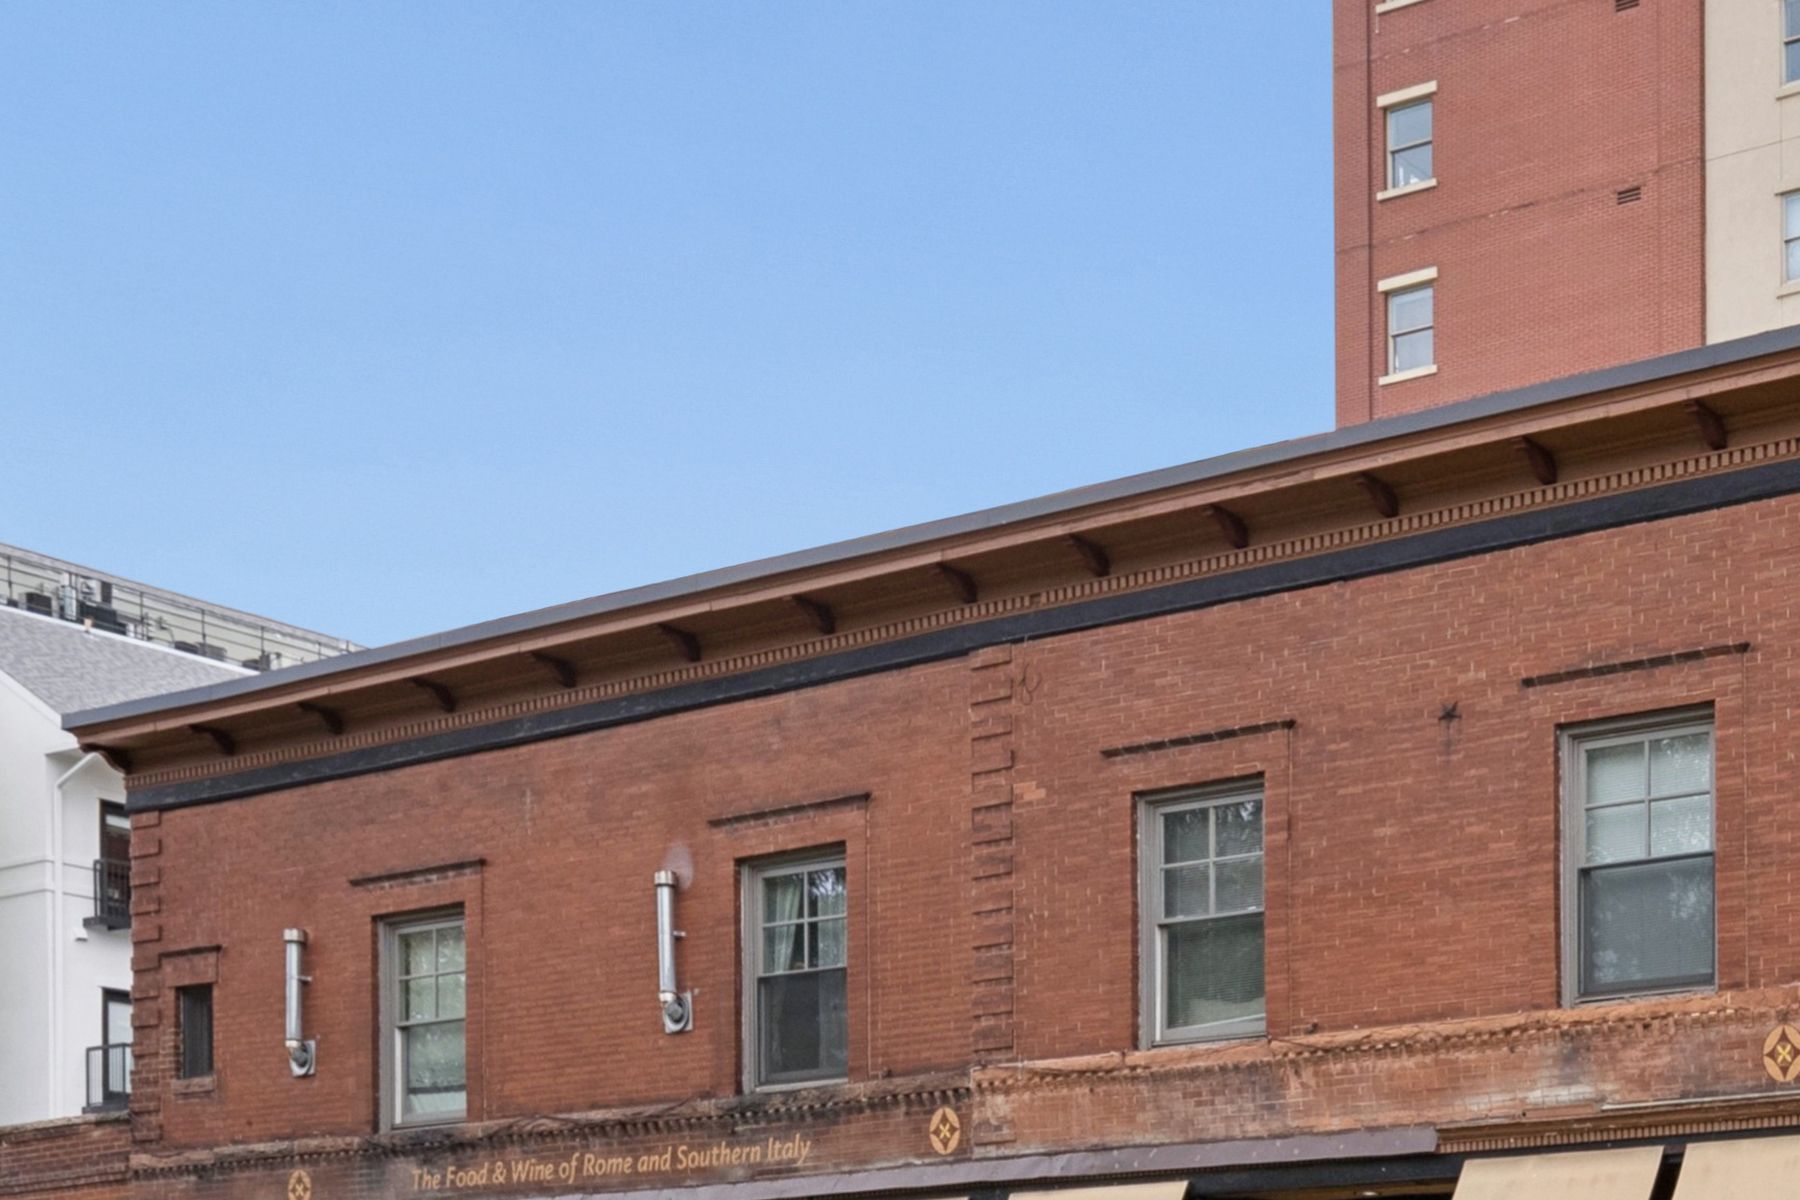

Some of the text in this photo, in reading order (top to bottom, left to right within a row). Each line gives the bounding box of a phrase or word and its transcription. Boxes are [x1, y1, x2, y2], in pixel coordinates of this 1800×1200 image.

[411, 1133, 811, 1191] The Food & Wine of Rome and Southern Italy
